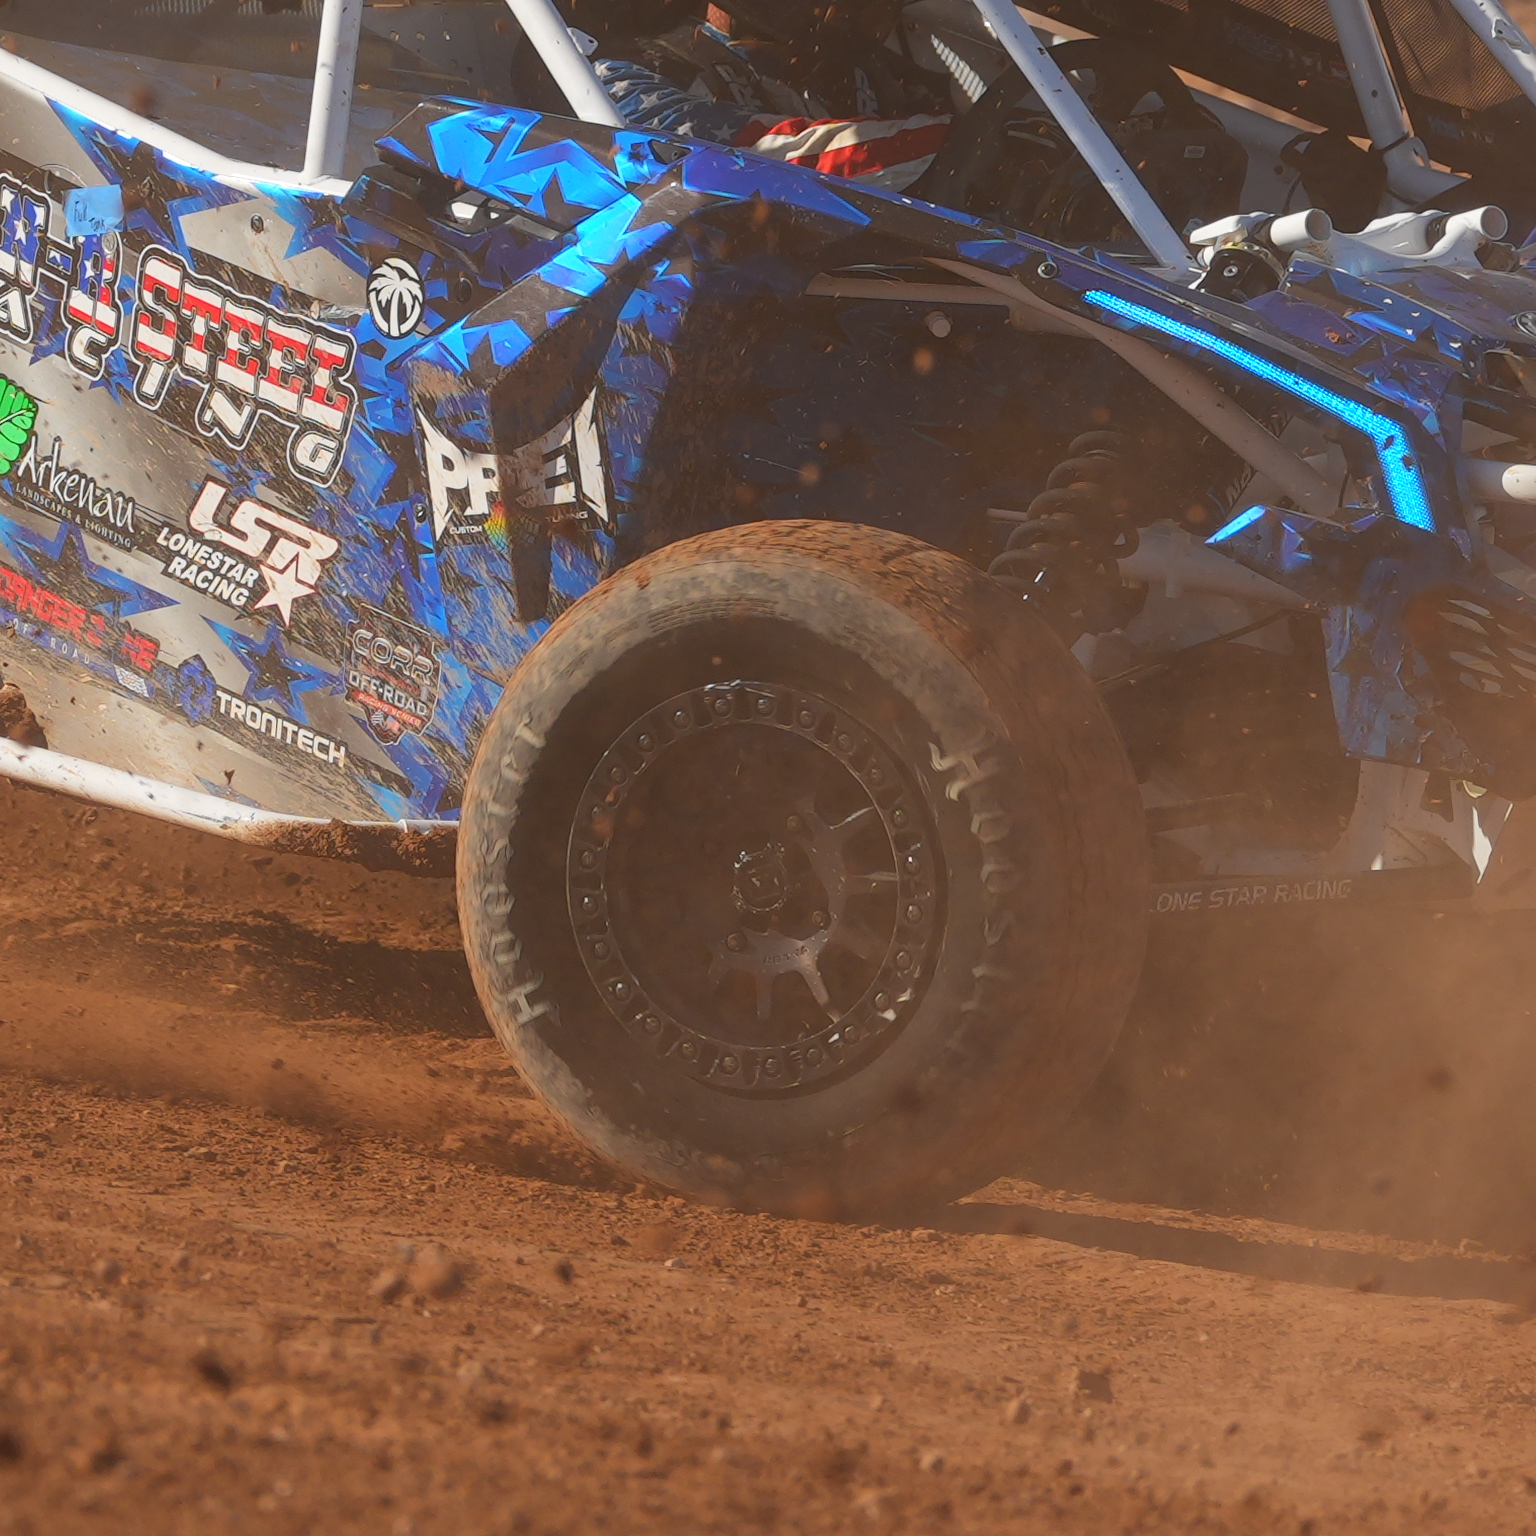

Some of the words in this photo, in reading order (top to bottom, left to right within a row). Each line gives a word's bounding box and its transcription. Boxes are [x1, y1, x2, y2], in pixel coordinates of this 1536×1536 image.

[137, 255, 356, 434] STEEL
[11, 436, 138, 534] Arkenau
[15, 482, 75, 521] LANDSCAPES
[87, 517, 132, 548] LIGHTING
[157, 527, 260, 587] LONESTAR
[189, 480, 343, 589] LSR
[449, 524, 484, 536] CUSTOM
[168, 558, 249, 609] RACING
[352, 628, 434, 685] CORR
[215, 691, 348, 767] TRONITECH
[1149, 890, 1204, 913] ONE
[1207, 885, 1268, 909] STAR
[1272, 878, 1353, 904] RACING
